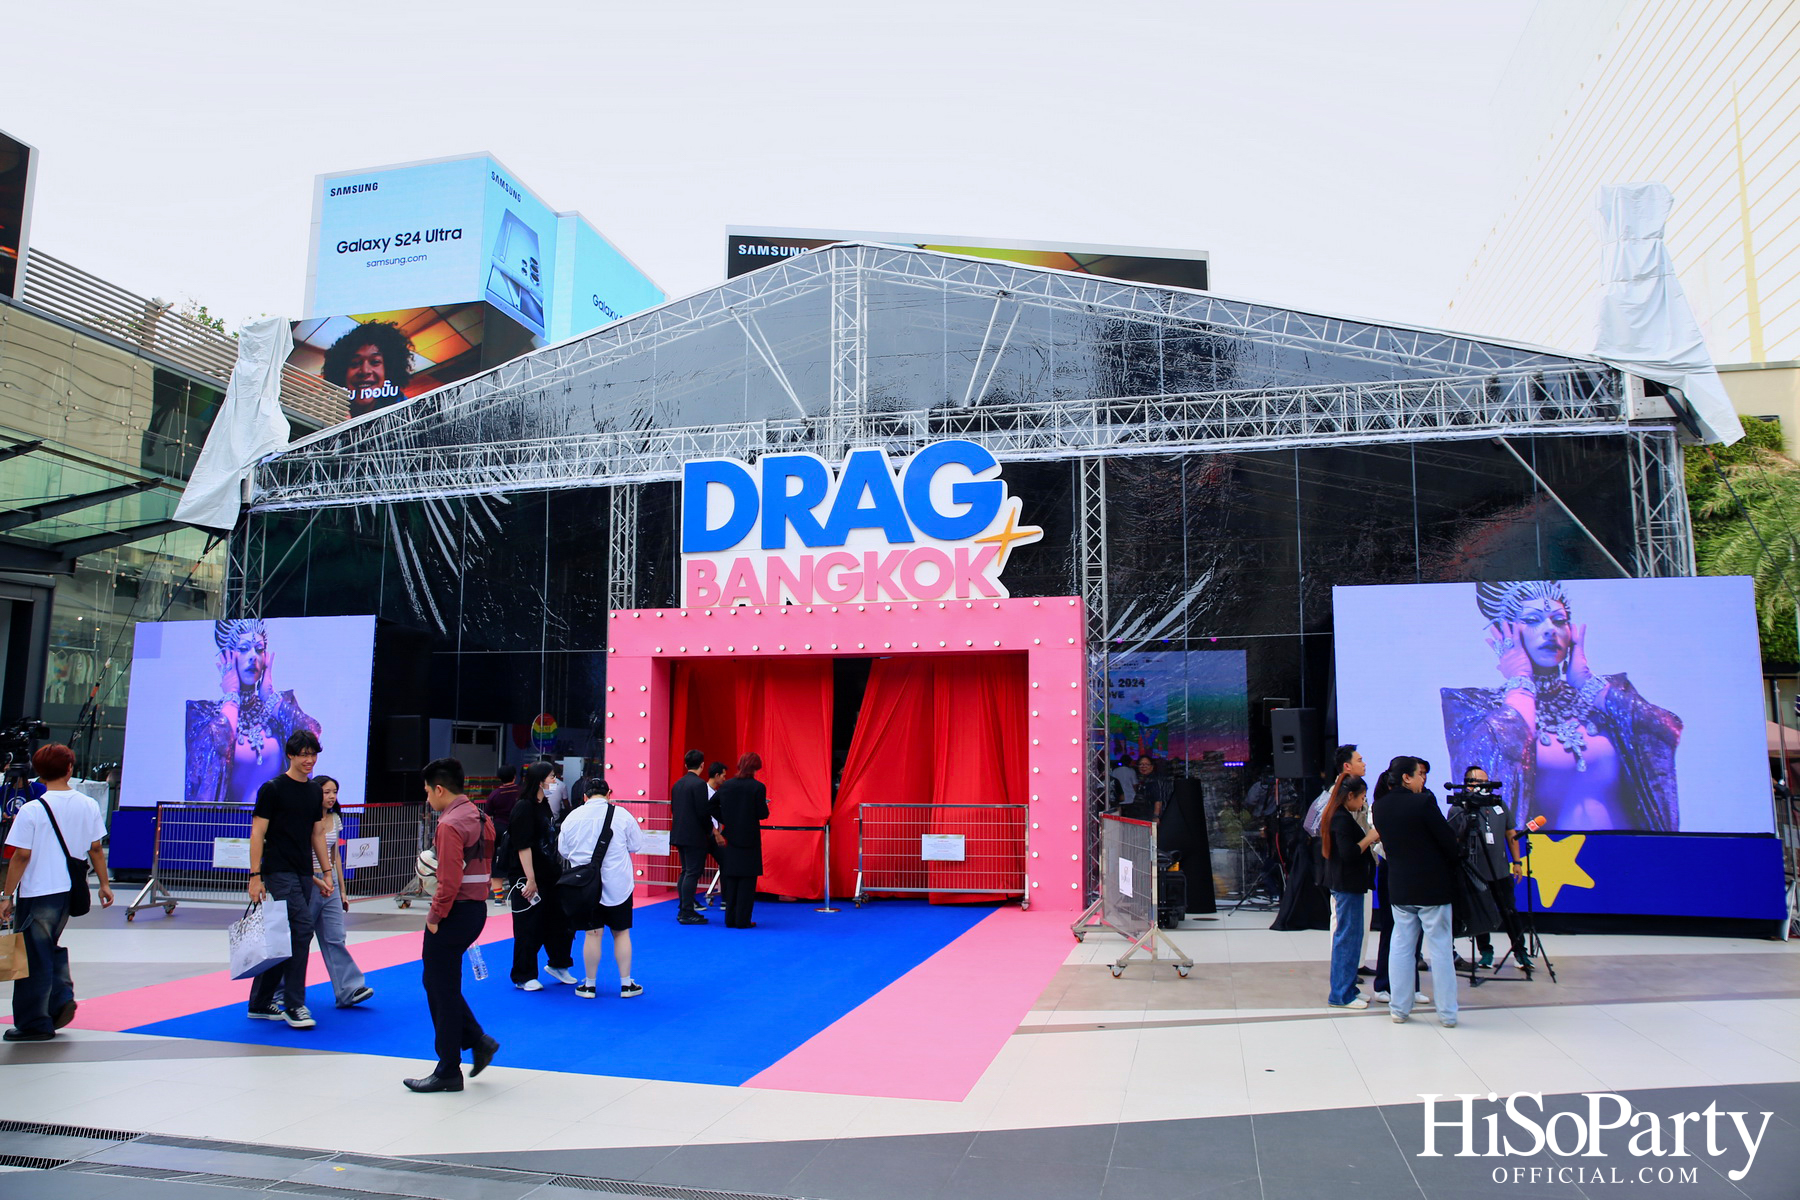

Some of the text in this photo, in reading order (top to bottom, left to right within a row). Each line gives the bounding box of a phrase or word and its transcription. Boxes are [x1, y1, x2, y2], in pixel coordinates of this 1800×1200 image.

[330, 182, 379, 197] SAMSUNG
[491, 171, 522, 203] SAMSUNG
[336, 228, 463, 254] Galaxy S24 Ultra
[366, 254, 428, 268] samsung.com
[682, 439, 1004, 553] DRAG
[685, 546, 1002, 608] BANGKOK
